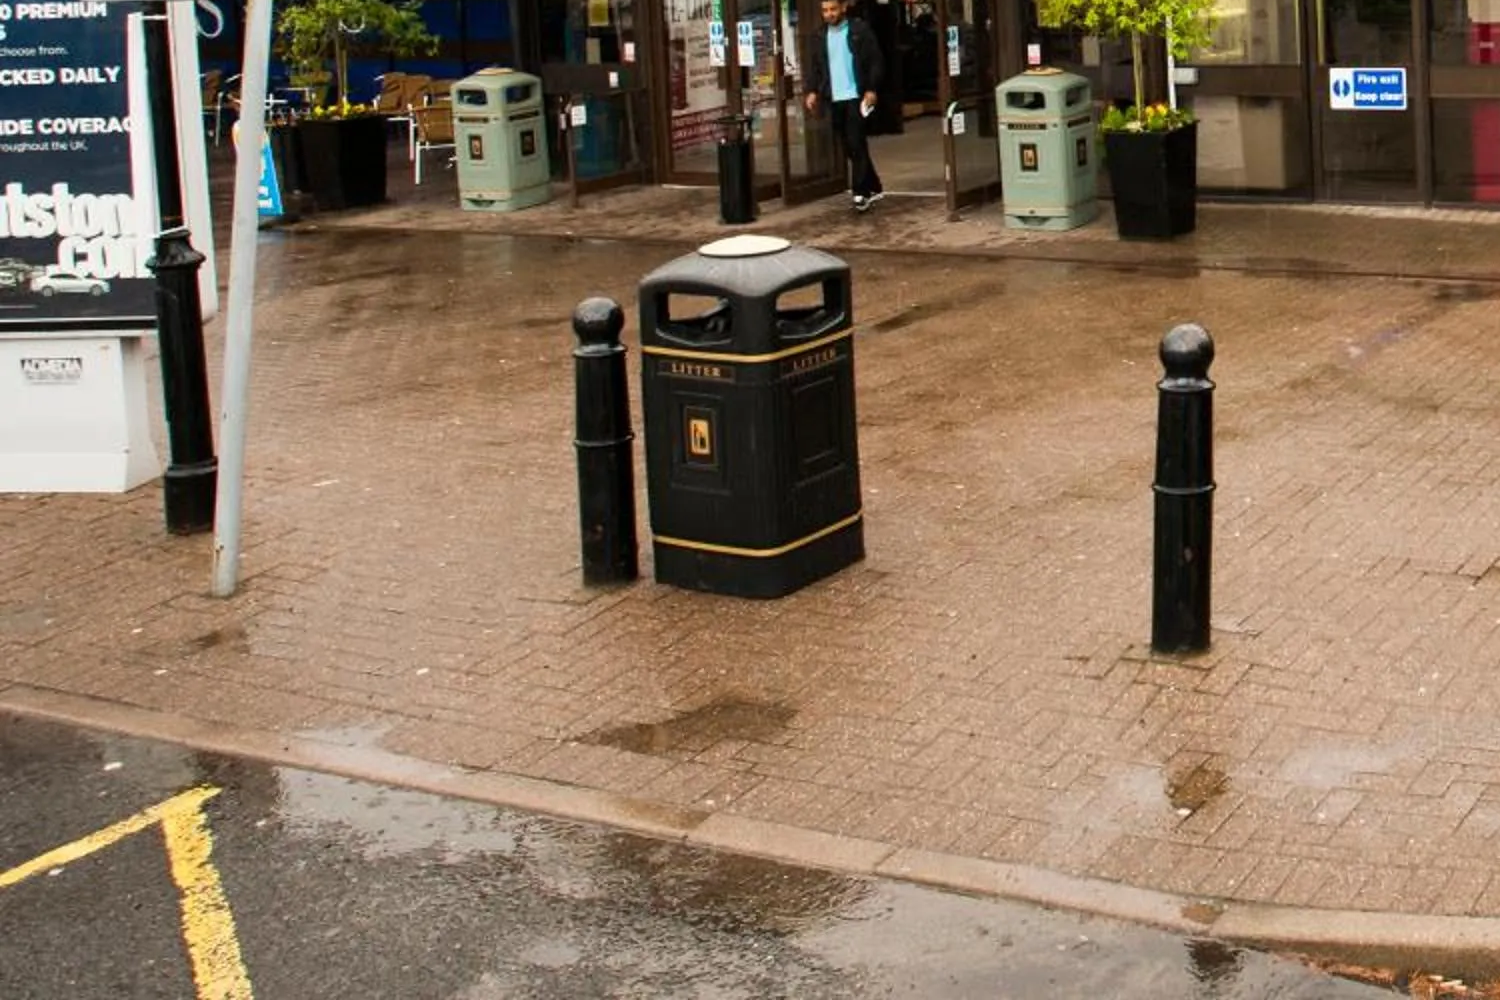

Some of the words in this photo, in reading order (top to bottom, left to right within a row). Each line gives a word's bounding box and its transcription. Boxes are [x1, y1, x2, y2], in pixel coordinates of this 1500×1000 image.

[15, 1, 108, 19] PREMIUM
[60, 66, 121, 84] DAILY
[793, 350, 836, 371] LITTER
[671, 362, 721, 378] LITTER
